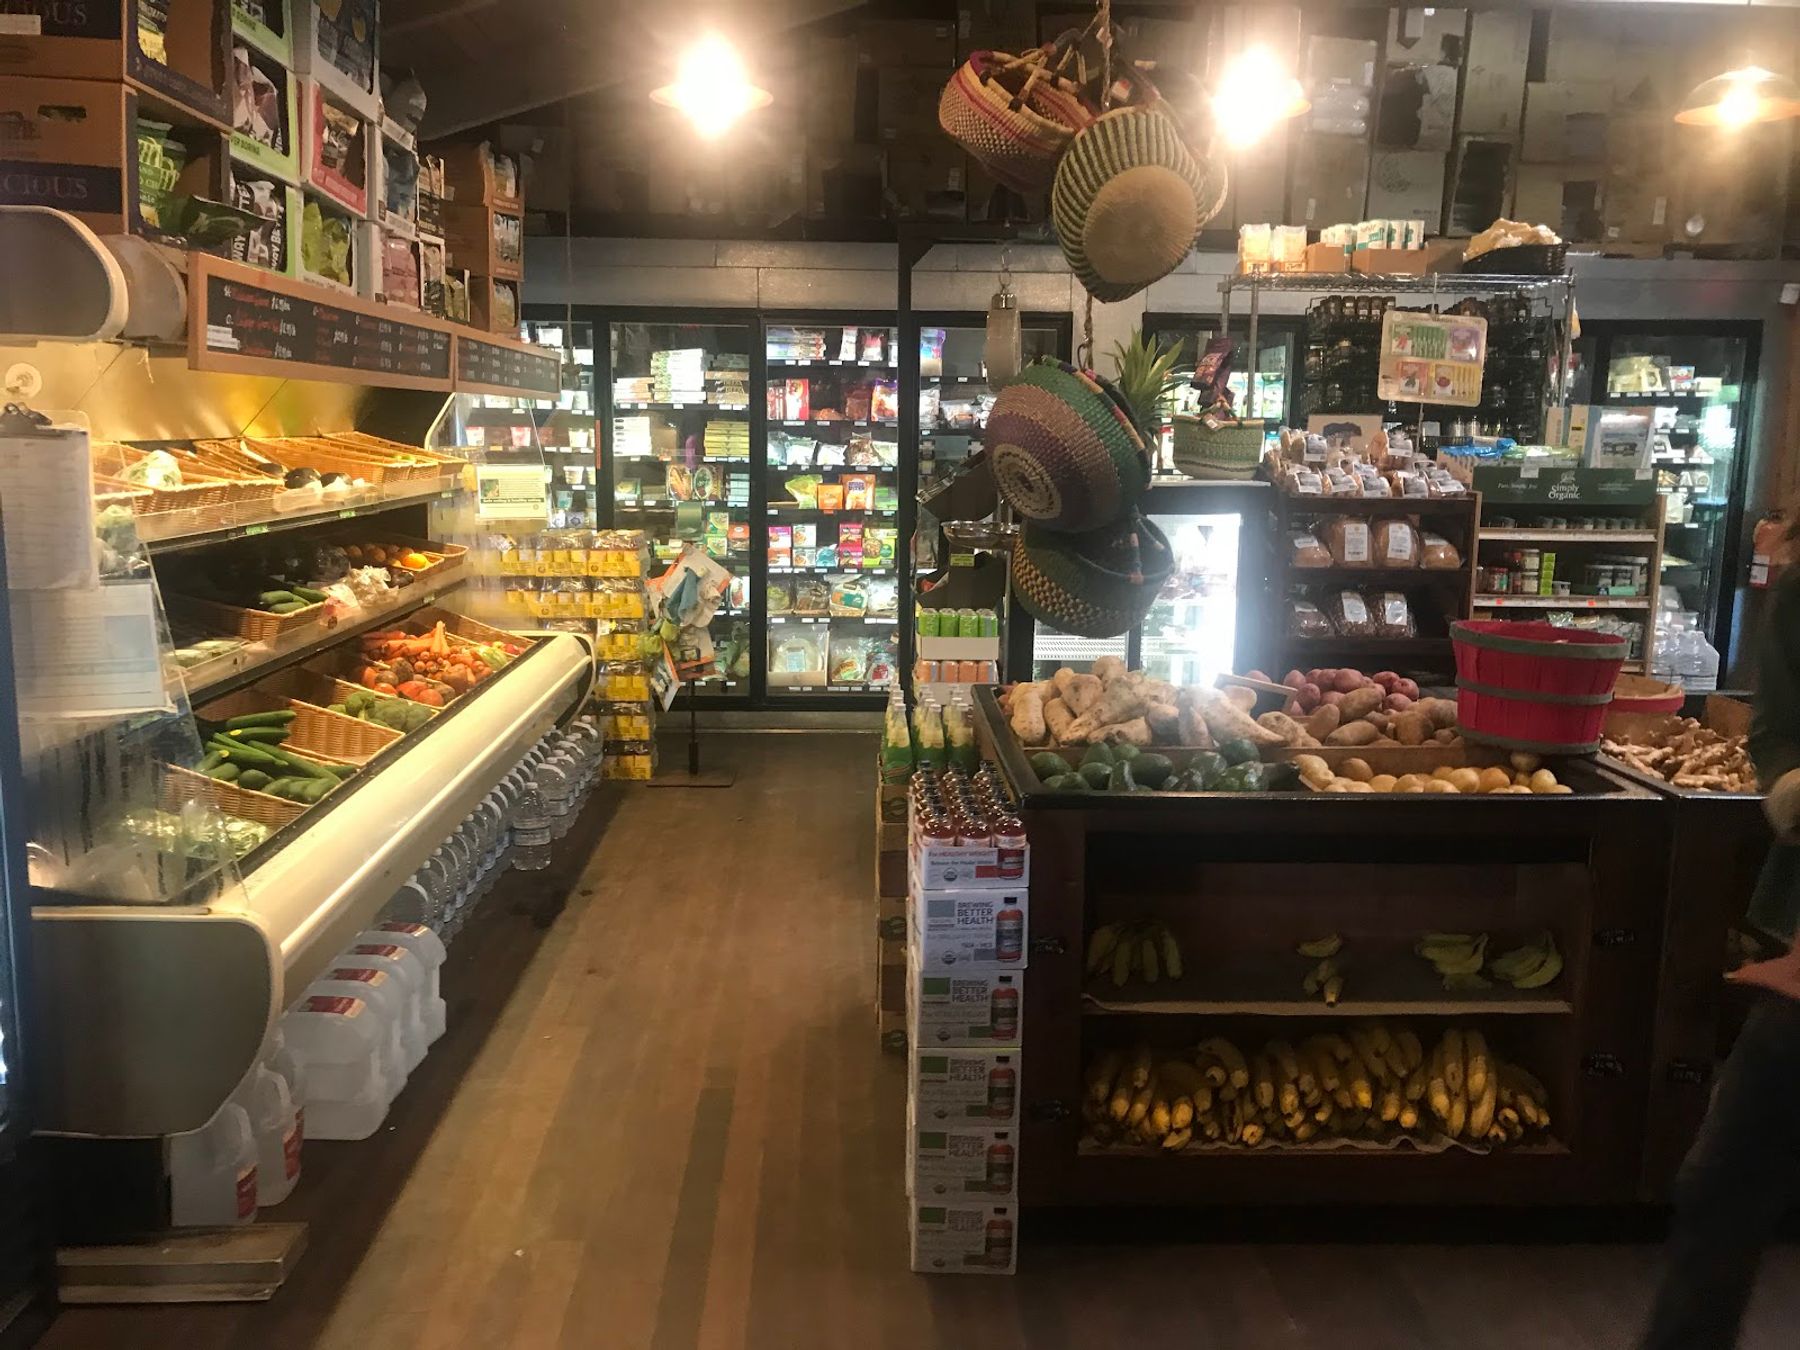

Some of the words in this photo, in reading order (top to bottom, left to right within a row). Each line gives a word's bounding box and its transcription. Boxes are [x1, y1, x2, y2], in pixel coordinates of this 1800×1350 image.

[1551, 484, 1580, 494] Simply
[1548, 491, 1581, 500] Organic
[957, 908, 993, 917] BETTER
[957, 917, 993, 925] HEALTH
